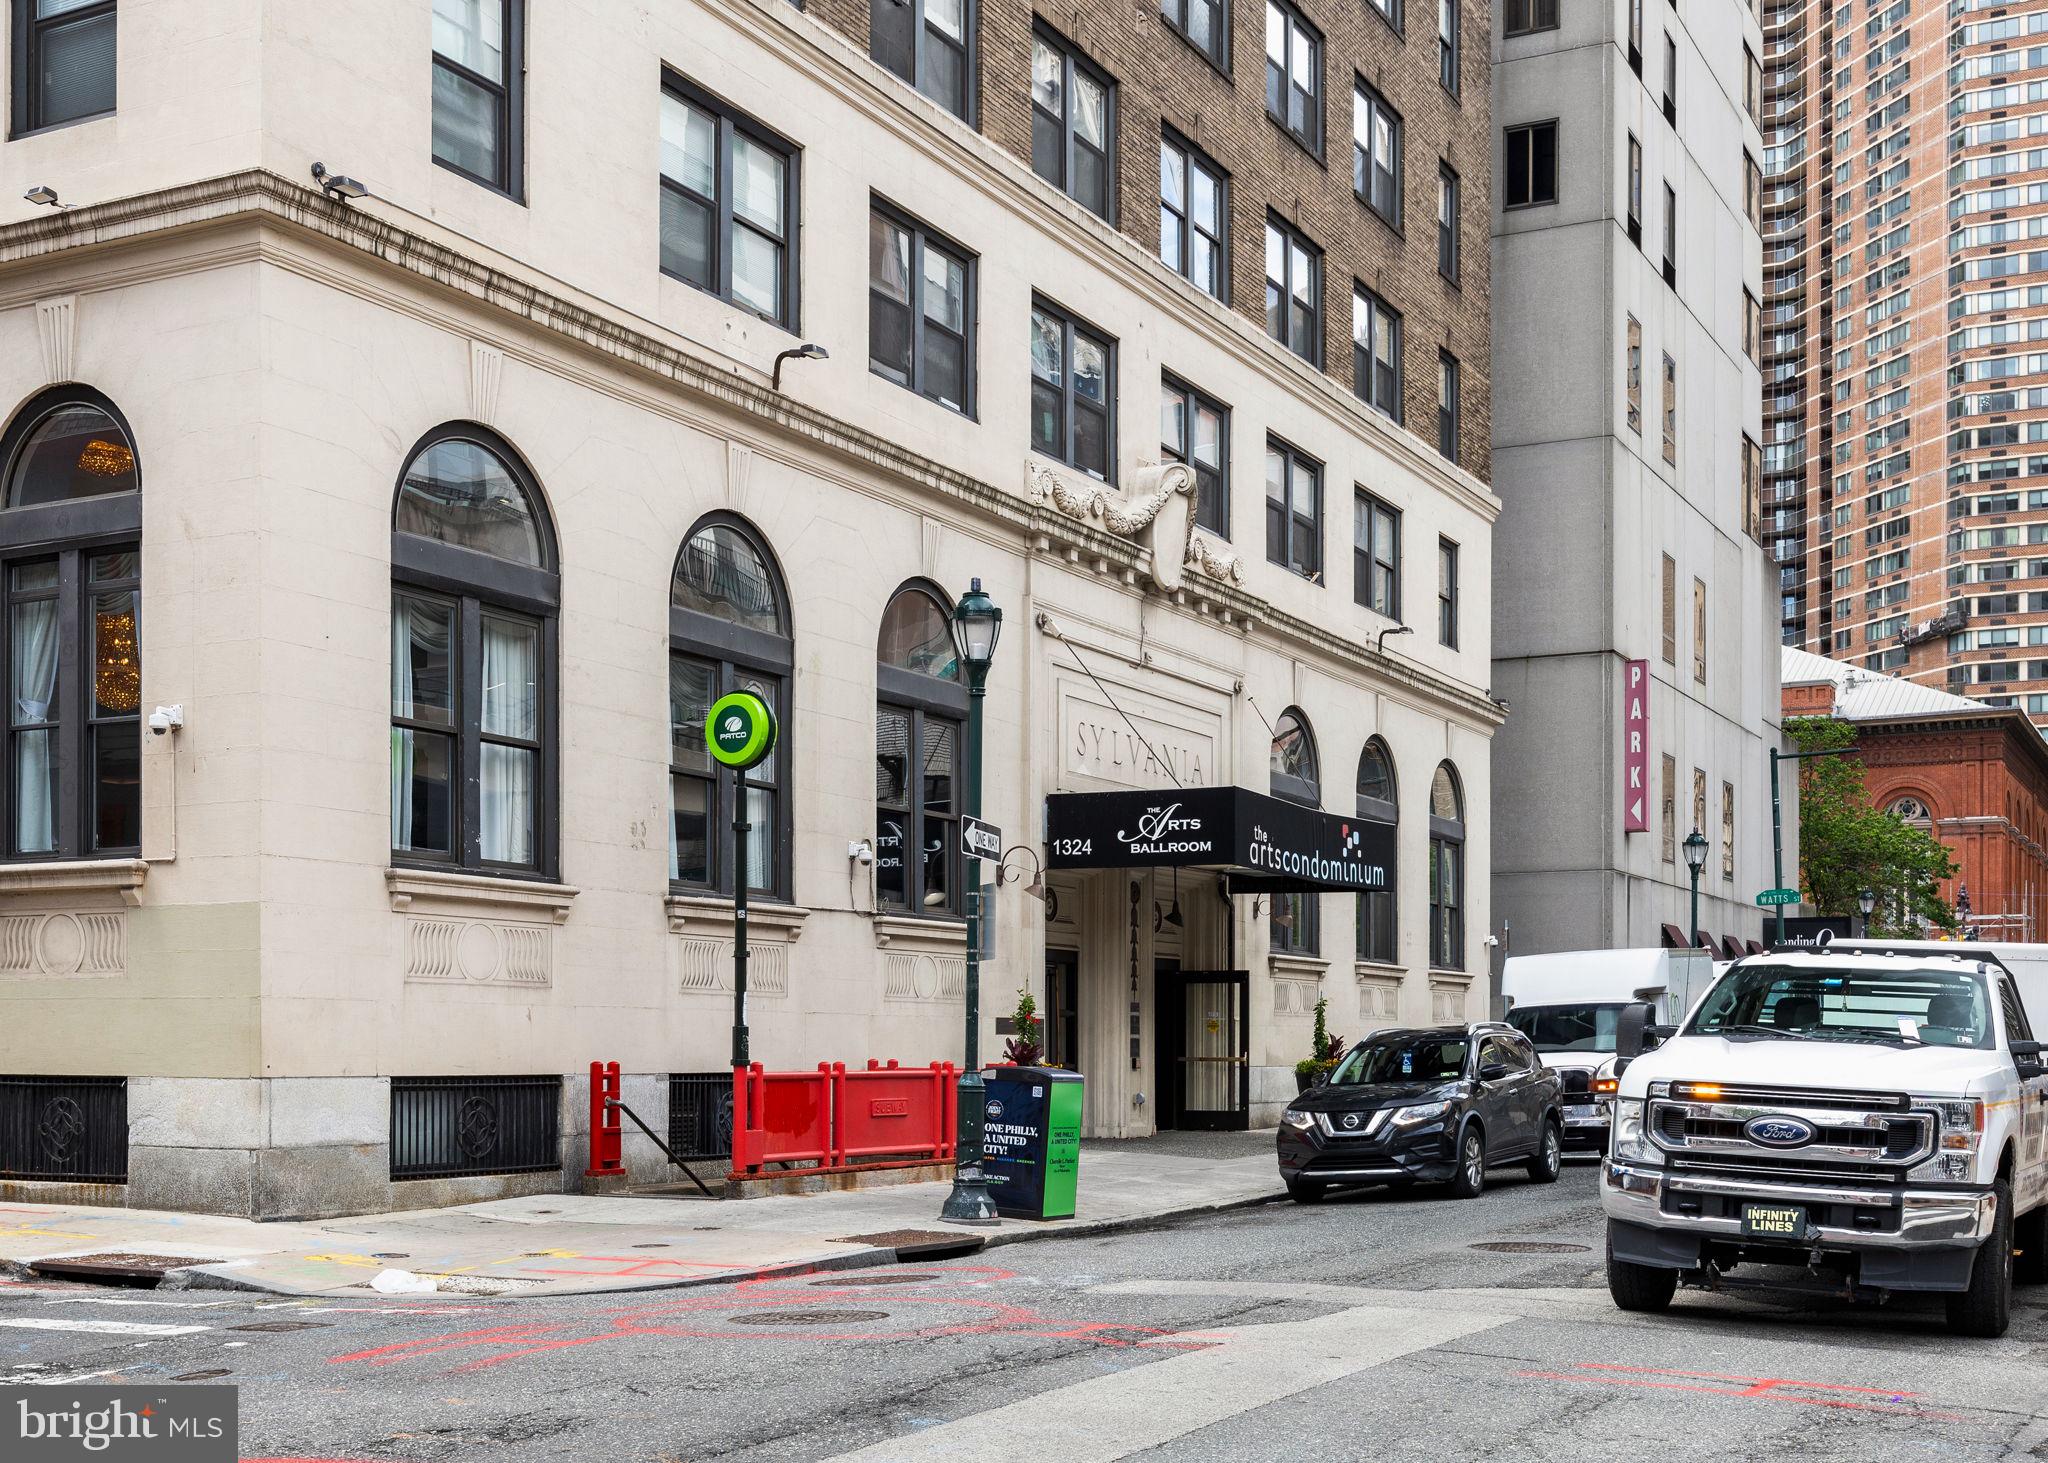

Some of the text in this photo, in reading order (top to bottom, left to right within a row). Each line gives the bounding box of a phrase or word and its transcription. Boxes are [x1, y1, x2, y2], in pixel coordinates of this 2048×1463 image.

[1630, 666, 1642, 789] PARK
[719, 731, 747, 740] PATCO
[1076, 721, 1205, 786] SYLVANIA
[1253, 824, 1268, 843] the
[974, 831, 999, 851] ONE WAY
[1052, 838, 1092, 855] 1324
[1130, 841, 1212, 854] BALLROOM
[1760, 894, 1789, 904] WATTS
[984, 1122, 1038, 1137] ONE PHILLY,
[1762, 1123, 1796, 1139] Ford
[983, 1133, 1027, 1146] A UNITED
[983, 1145, 1008, 1155] CITY!
[1747, 1208, 1799, 1222] INFINITY
[1751, 1220, 1794, 1232] LINES
